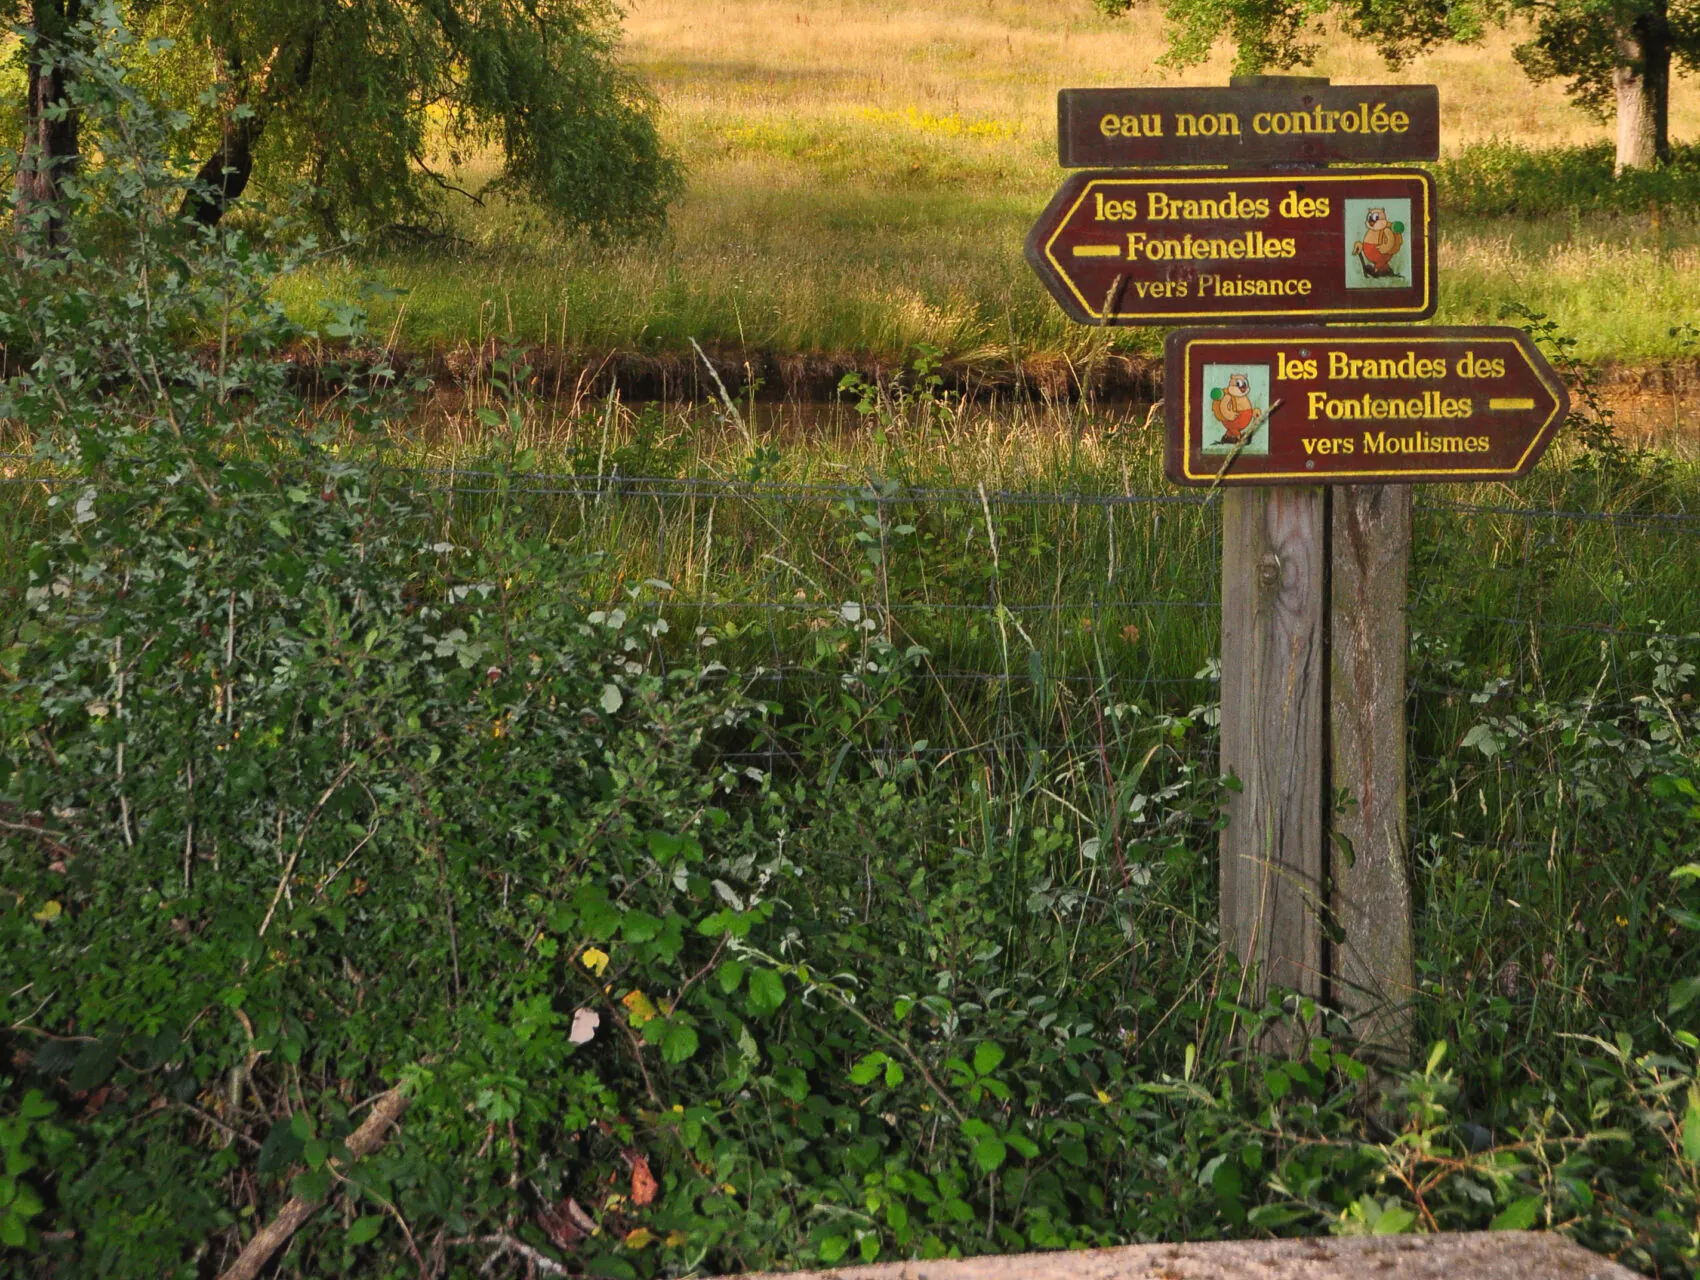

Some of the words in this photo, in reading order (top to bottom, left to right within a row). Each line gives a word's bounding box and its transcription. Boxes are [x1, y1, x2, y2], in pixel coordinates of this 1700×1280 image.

[1100, 112, 1163, 137] eau
[1175, 111, 1240, 136] non
[1253, 103, 1410, 135] controlée
[1095, 193, 1137, 220] les
[1147, 193, 1269, 220] Brandes
[1279, 190, 1330, 218] des
[1127, 232, 1296, 261] Fontenelles
[1135, 277, 1188, 298] vers
[1197, 275, 1311, 297] Plaisance
[1277, 353, 1318, 380] les
[1328, 352, 1447, 380] Brandes
[1457, 353, 1505, 378] des
[1308, 391, 1472, 420] Fontenelles
[1302, 435, 1354, 455] vers
[1363, 432, 1489, 453] Moulismes
